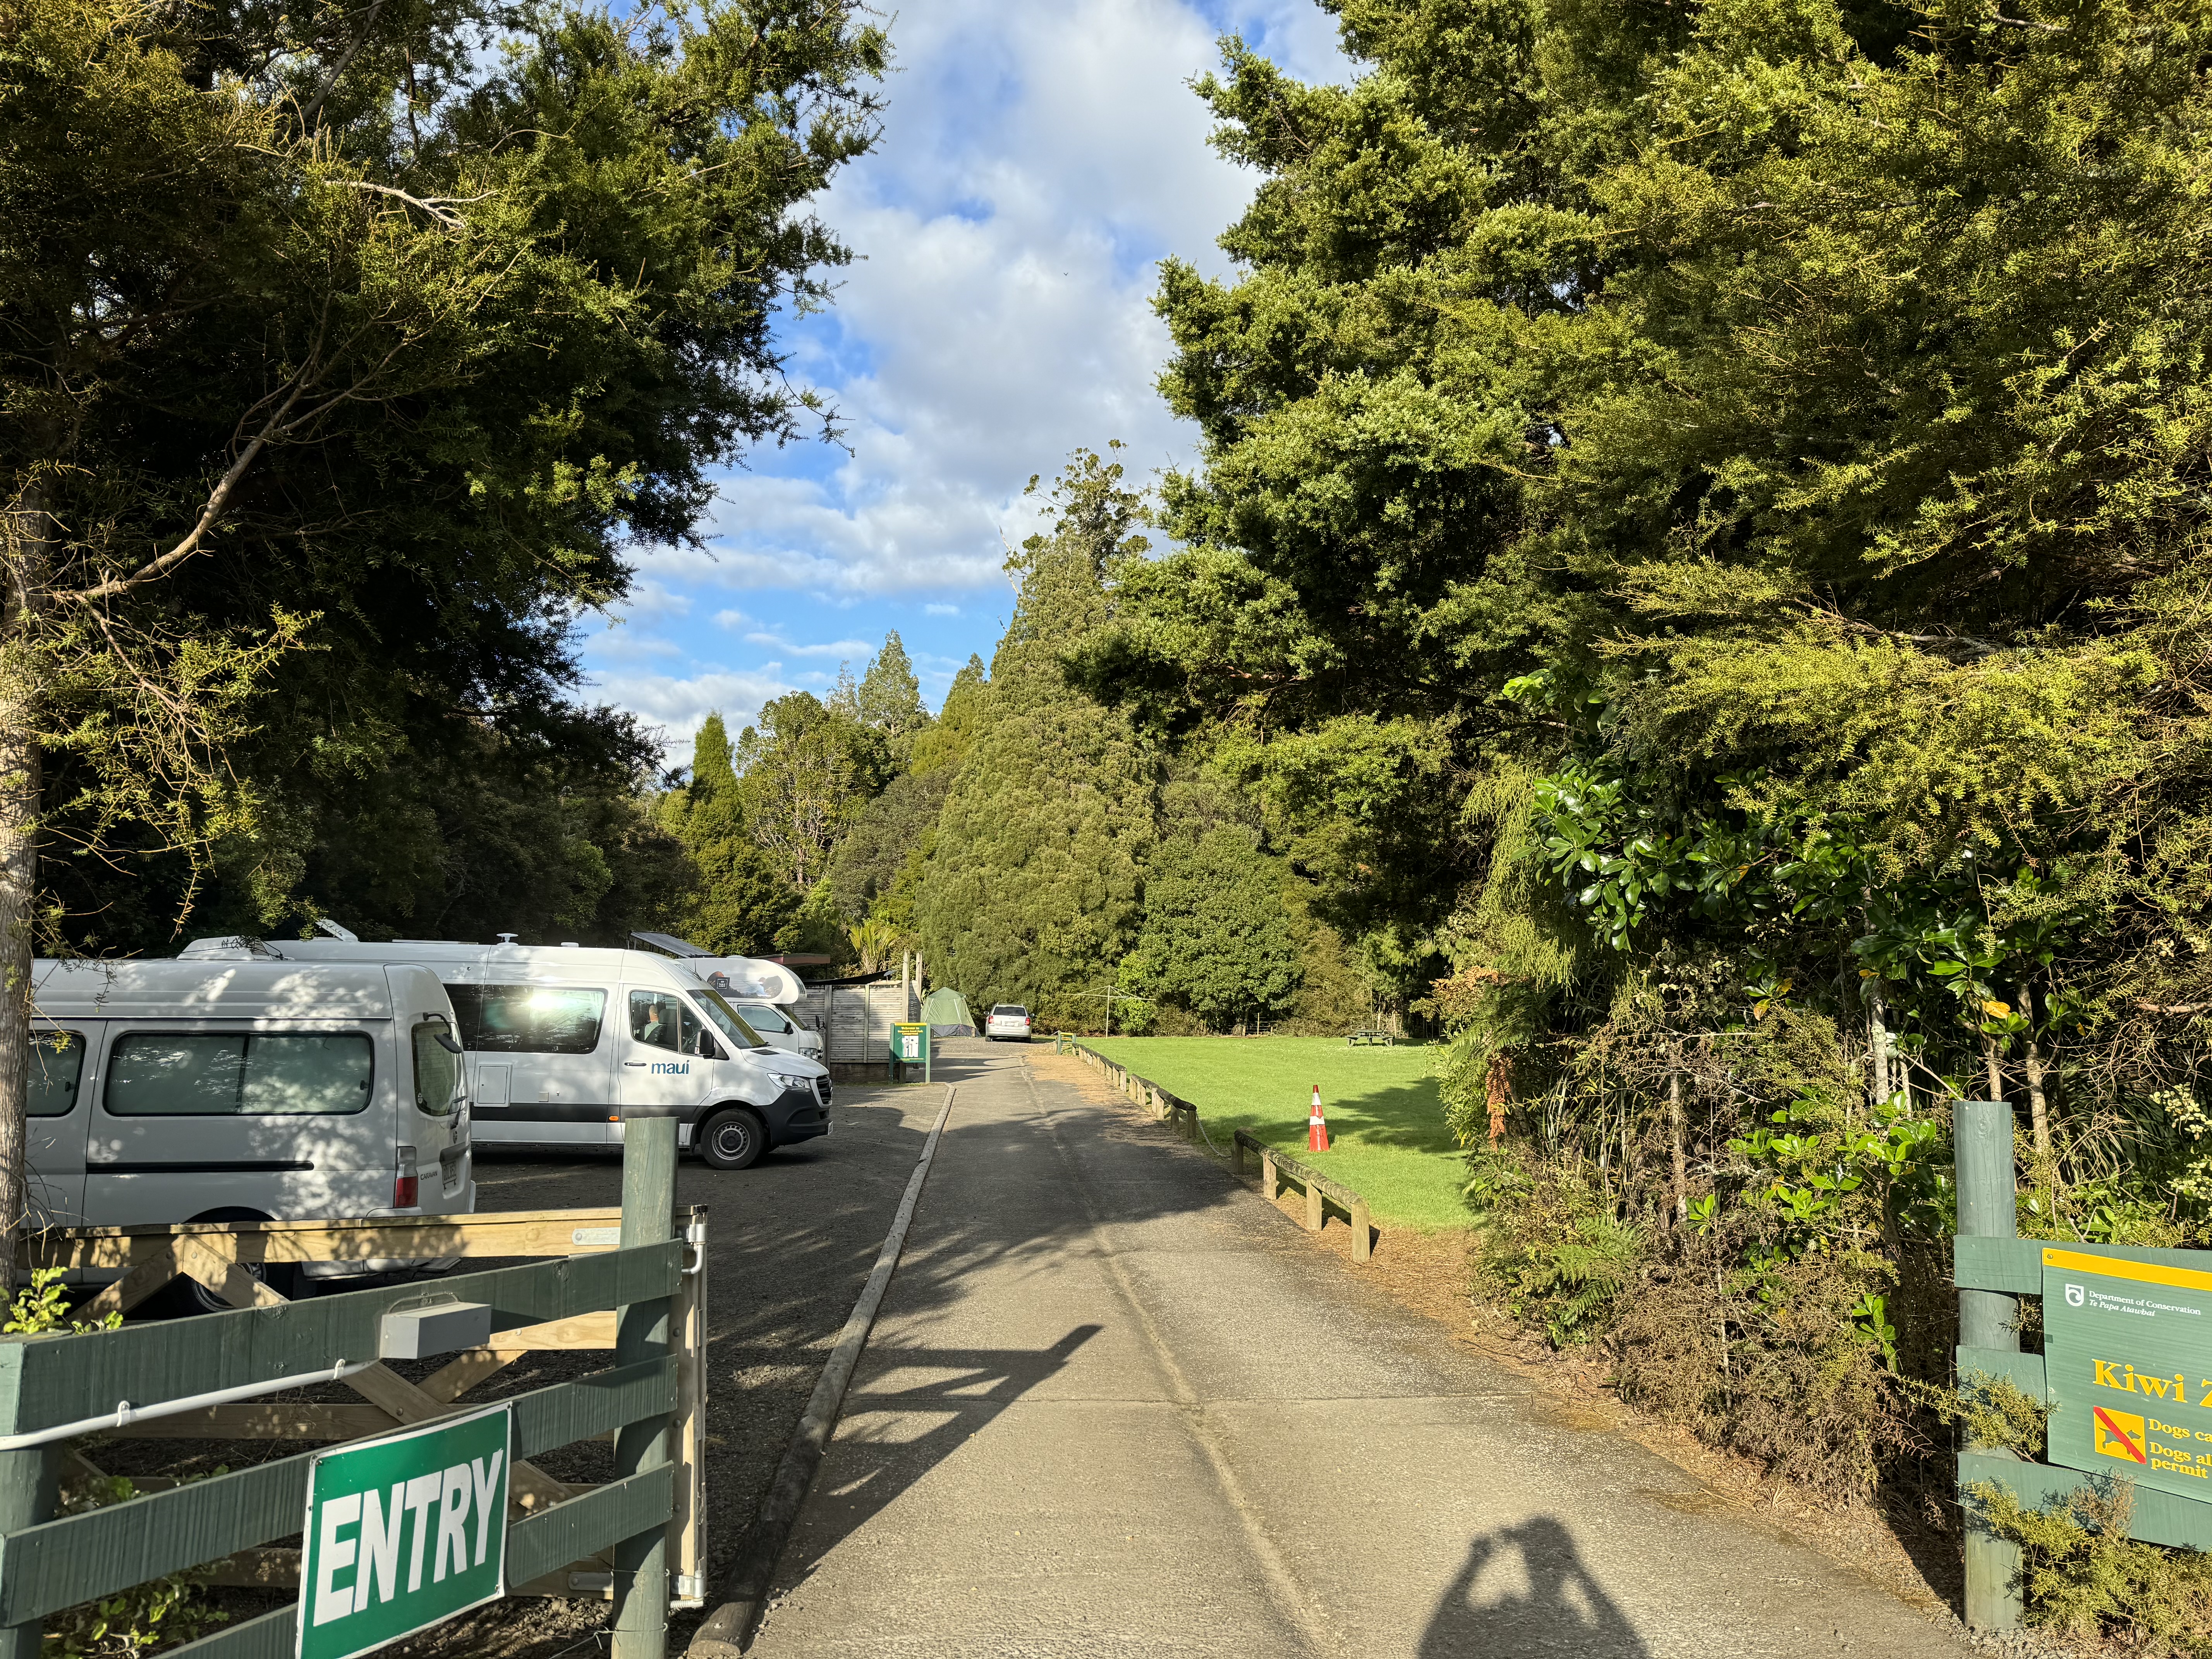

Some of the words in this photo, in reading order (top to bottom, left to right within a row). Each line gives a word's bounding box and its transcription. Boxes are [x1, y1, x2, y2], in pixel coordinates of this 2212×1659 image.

[651, 1060, 689, 1074] maui
[420, 1171, 438, 1180] CARAVAN
[2089, 1290, 2134, 1305] Department
[2146, 1301, 2201, 1315] Conservation
[2099, 1301, 2119, 1311] Papa
[2120, 1305, 2155, 1317] Atawhai
[2092, 1358, 2188, 1403] Kiwi
[2148, 1419, 2190, 1439] Dogs
[2149, 1442, 2191, 1463] Dogs
[2196, 1453, 2212, 1467] al
[2150, 1458, 2208, 1479] permit
[313, 1448, 503, 1627] ENTRY
